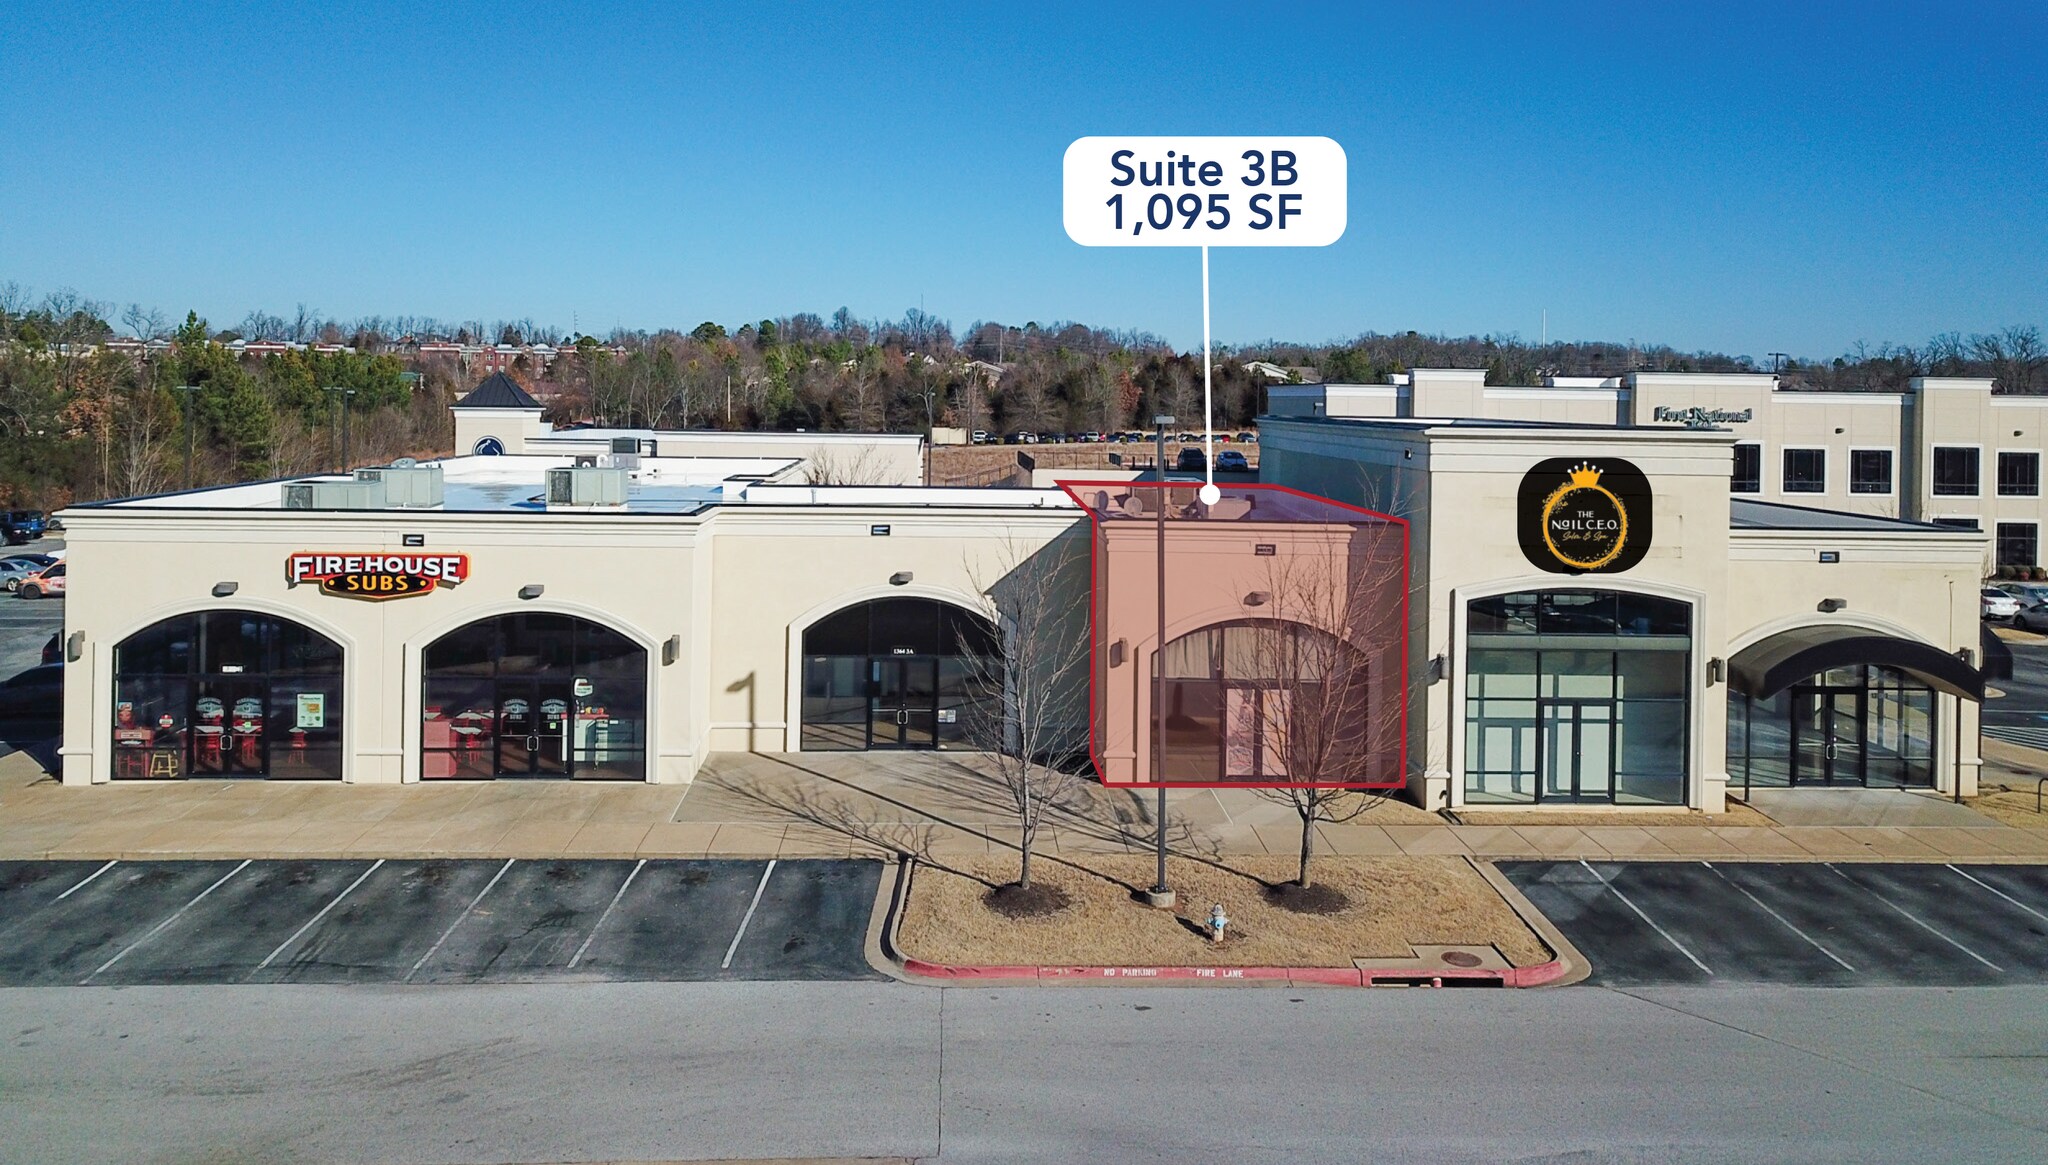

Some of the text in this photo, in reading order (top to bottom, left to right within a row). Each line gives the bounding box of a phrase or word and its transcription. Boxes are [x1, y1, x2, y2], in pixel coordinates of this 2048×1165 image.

[1654, 406, 1752, 423] First National
[1577, 510, 1594, 518] THE
[1593, 530, 1609, 541] Spa
[293, 556, 461, 584] FIREHOUSE
[346, 575, 409, 591] SUBS
[1103, 968, 1244, 978] NO PARKING FIRE LANE
